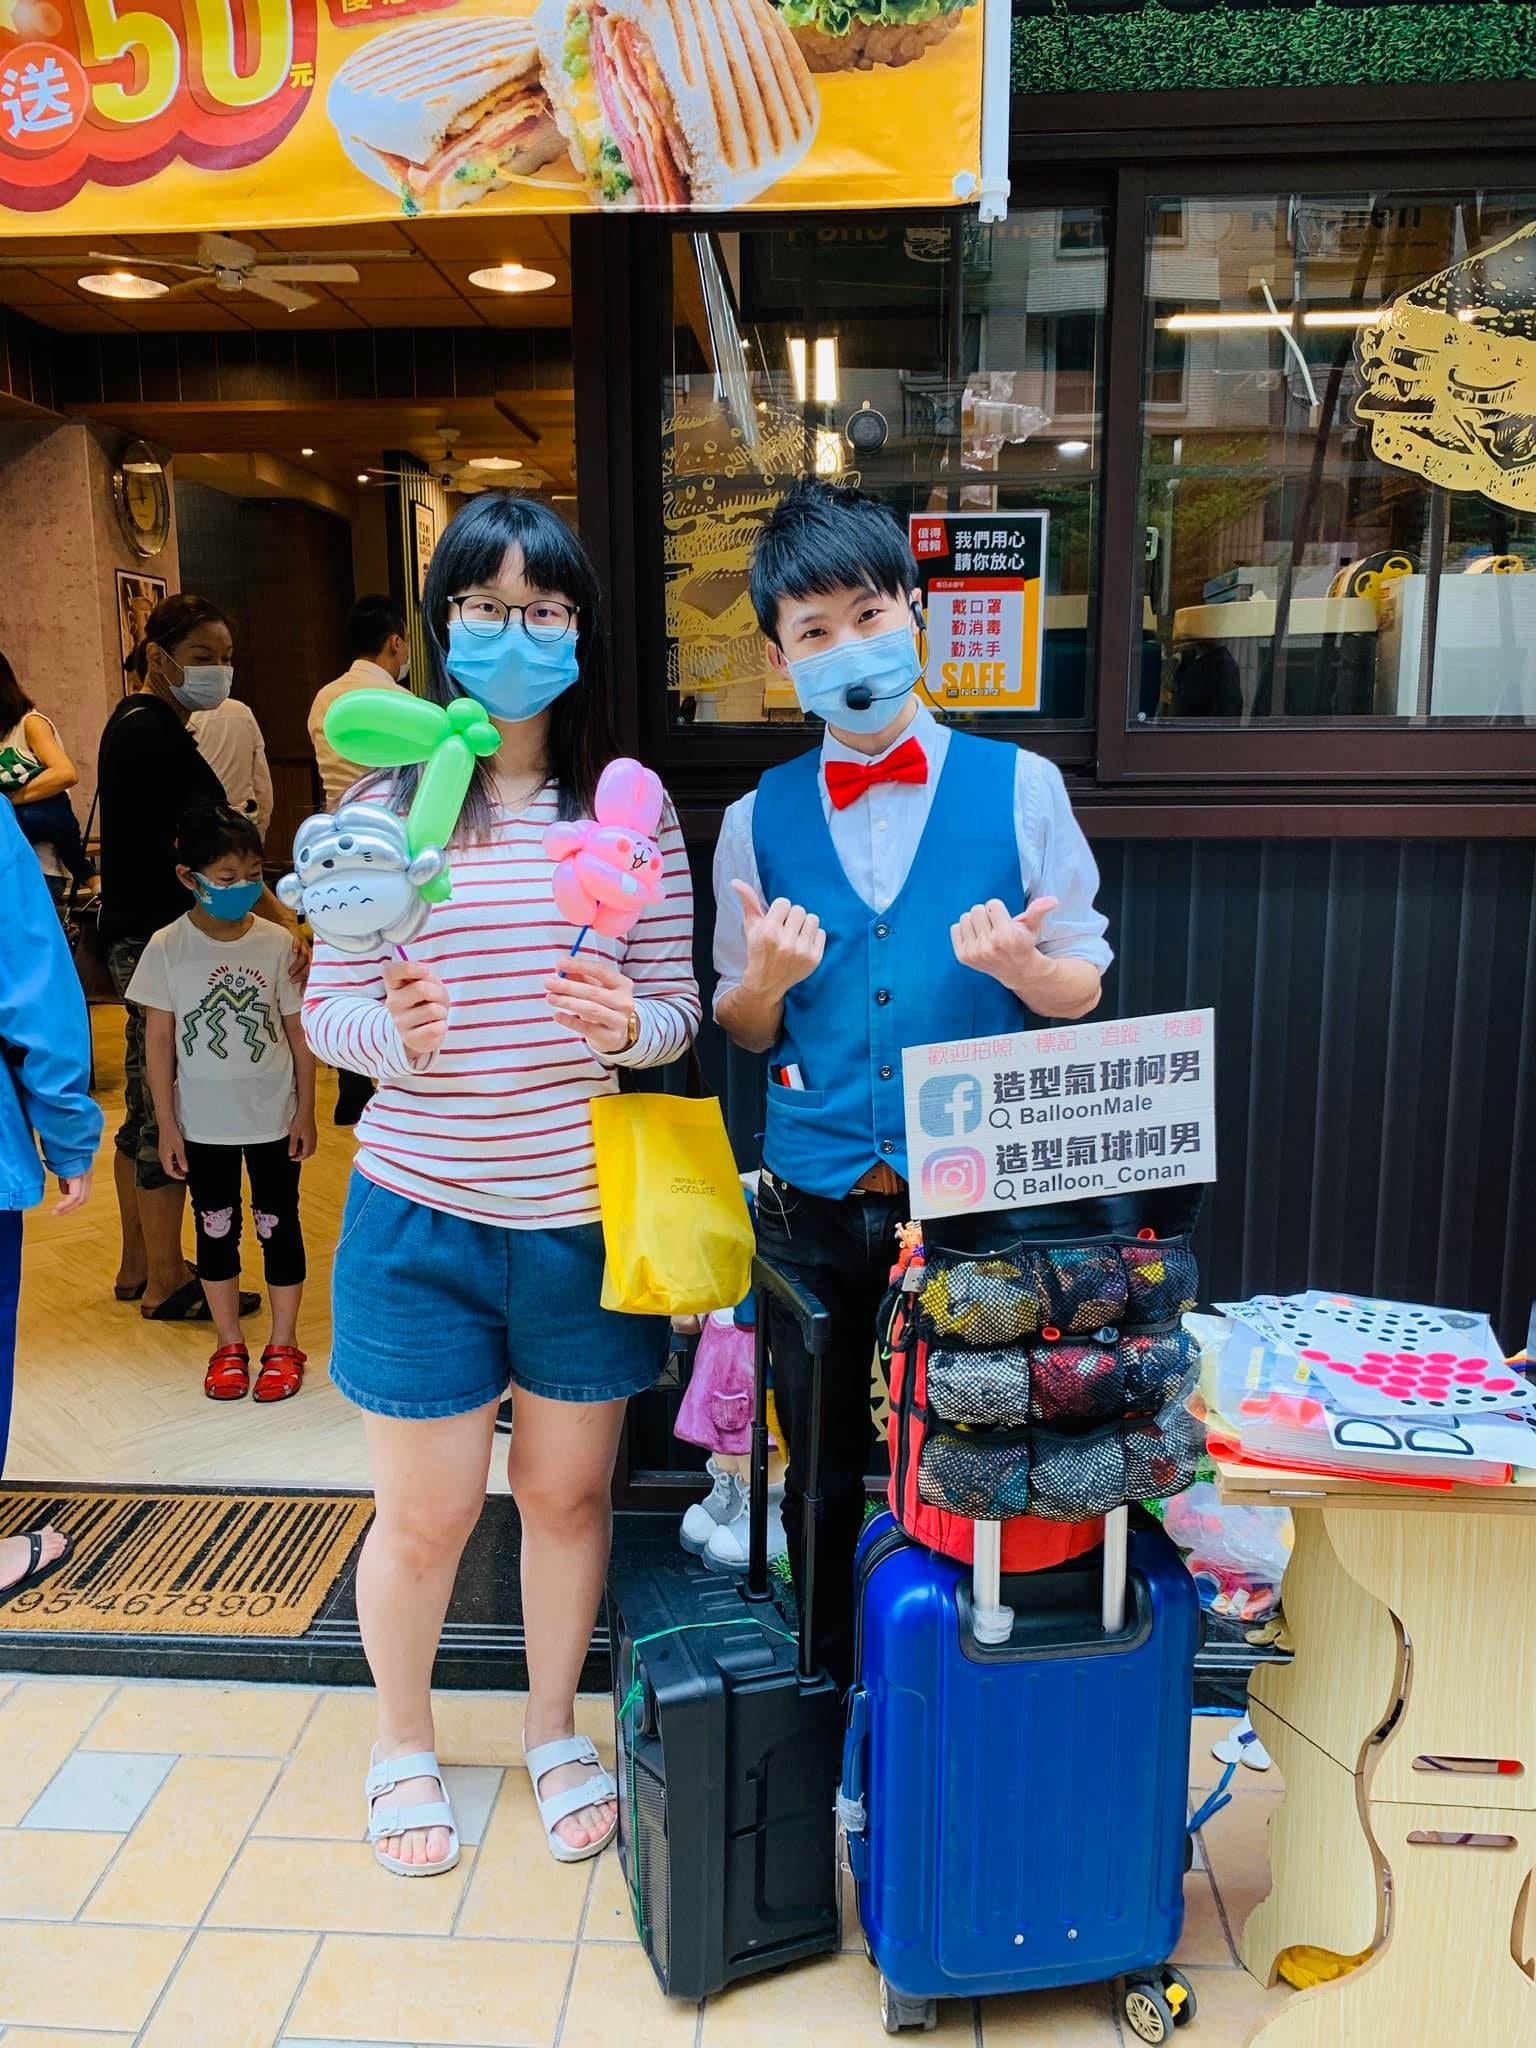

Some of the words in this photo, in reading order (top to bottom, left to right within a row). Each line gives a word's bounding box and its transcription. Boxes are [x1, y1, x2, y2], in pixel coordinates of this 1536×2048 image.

[1, 57, 73, 139] 送
[80, 0, 294, 123] 50
[289, 62, 315, 89] 元
[917, 527, 942, 540] 值得
[955, 530, 1026, 549] 我們用心
[917, 540, 942, 552] 信賴
[954, 553, 1025, 571] 請你放心
[951, 598, 1002, 616] 戴口罩
[951, 619, 1001, 636] 勤消毒
[951, 641, 1001, 658] 勤洗手
[941, 661, 1007, 691] SAFE
[992, 1050, 1201, 1105] 造型氣球柯男
[1020, 1094, 1153, 1125] BalloonMale
[995, 1121, 1201, 1176] 造型氣球柯男
[1023, 1163, 1186, 1195] Balloon_Conan
